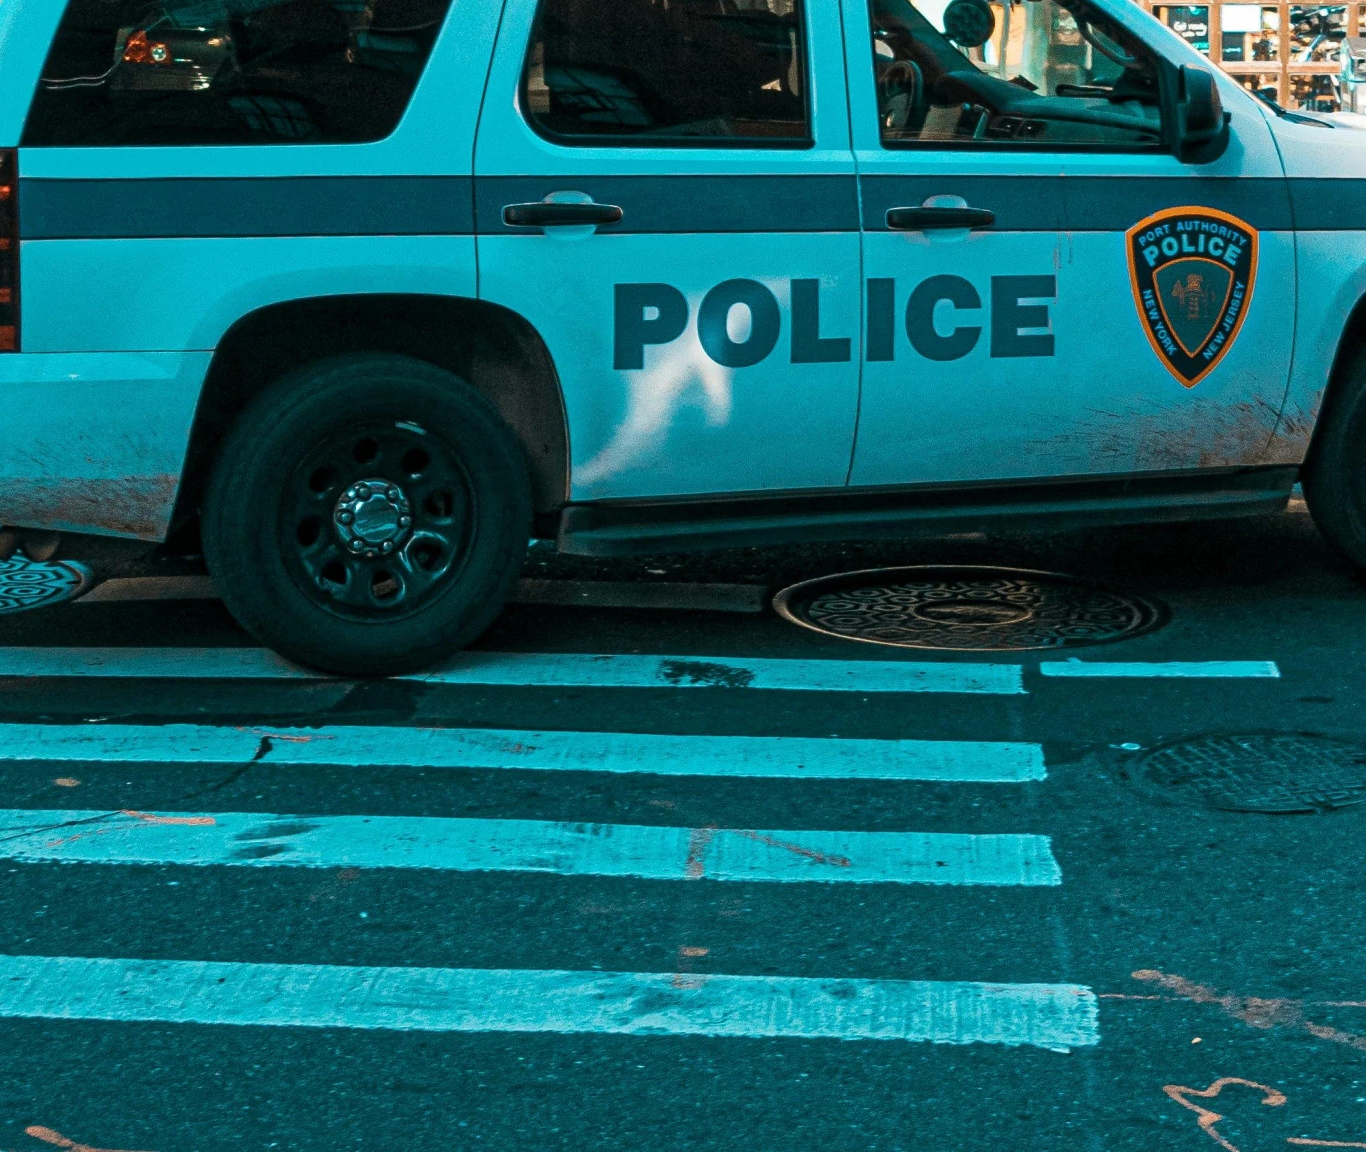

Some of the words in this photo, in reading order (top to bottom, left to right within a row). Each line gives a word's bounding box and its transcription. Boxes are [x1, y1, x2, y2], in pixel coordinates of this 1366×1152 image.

[1138, 224, 1171, 247] PORT
[1176, 220, 1248, 246] AUTHORITY
[1142, 233, 1243, 268] POLICE
[612, 274, 1057, 371] POLICE
[1142, 289, 1160, 321] NEW
[1154, 320, 1179, 356] YORK
[1202, 334, 1226, 360] NEW
[1224, 281, 1247, 332] JERSEY
